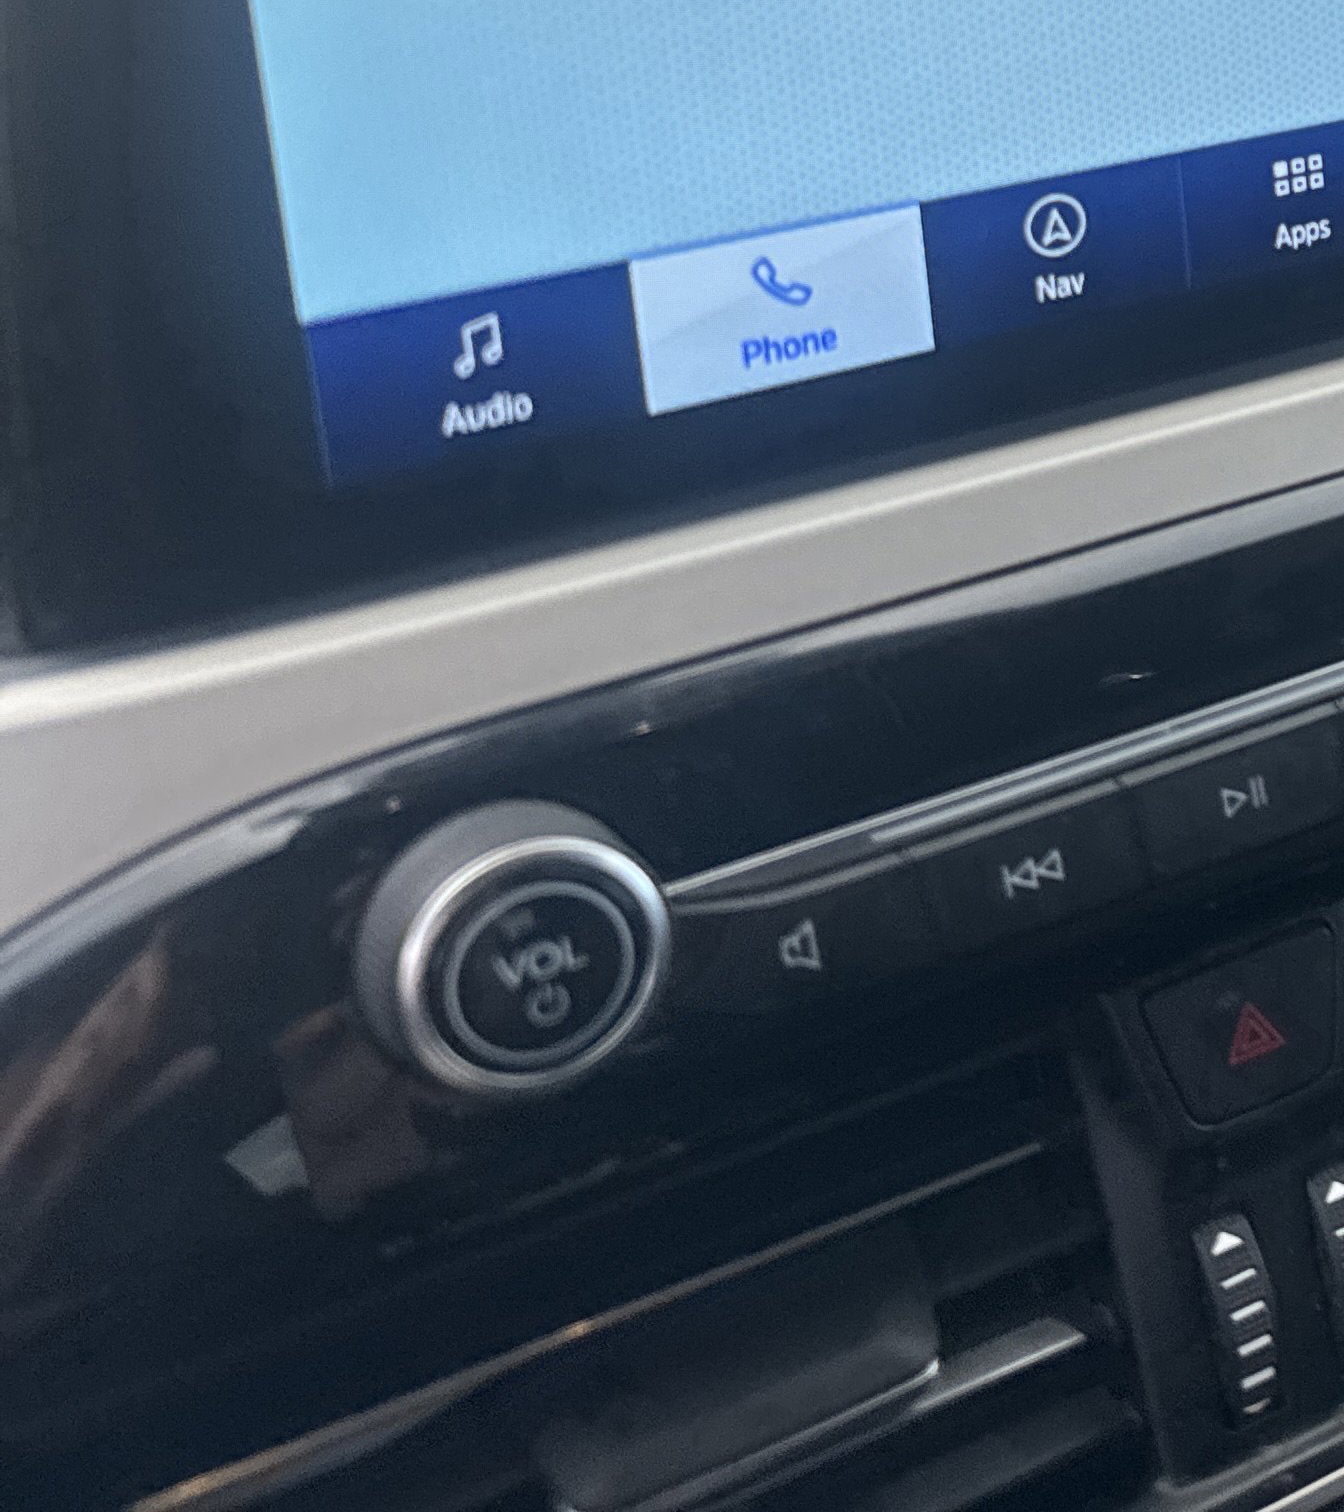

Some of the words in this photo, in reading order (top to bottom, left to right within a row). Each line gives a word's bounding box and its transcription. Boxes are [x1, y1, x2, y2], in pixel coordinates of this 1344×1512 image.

[1275, 216, 1333, 251] Apps
[1034, 272, 1086, 304] Nav
[741, 327, 838, 370] Phone
[442, 390, 534, 438] Audio
[493, 936, 591, 990] VOL
